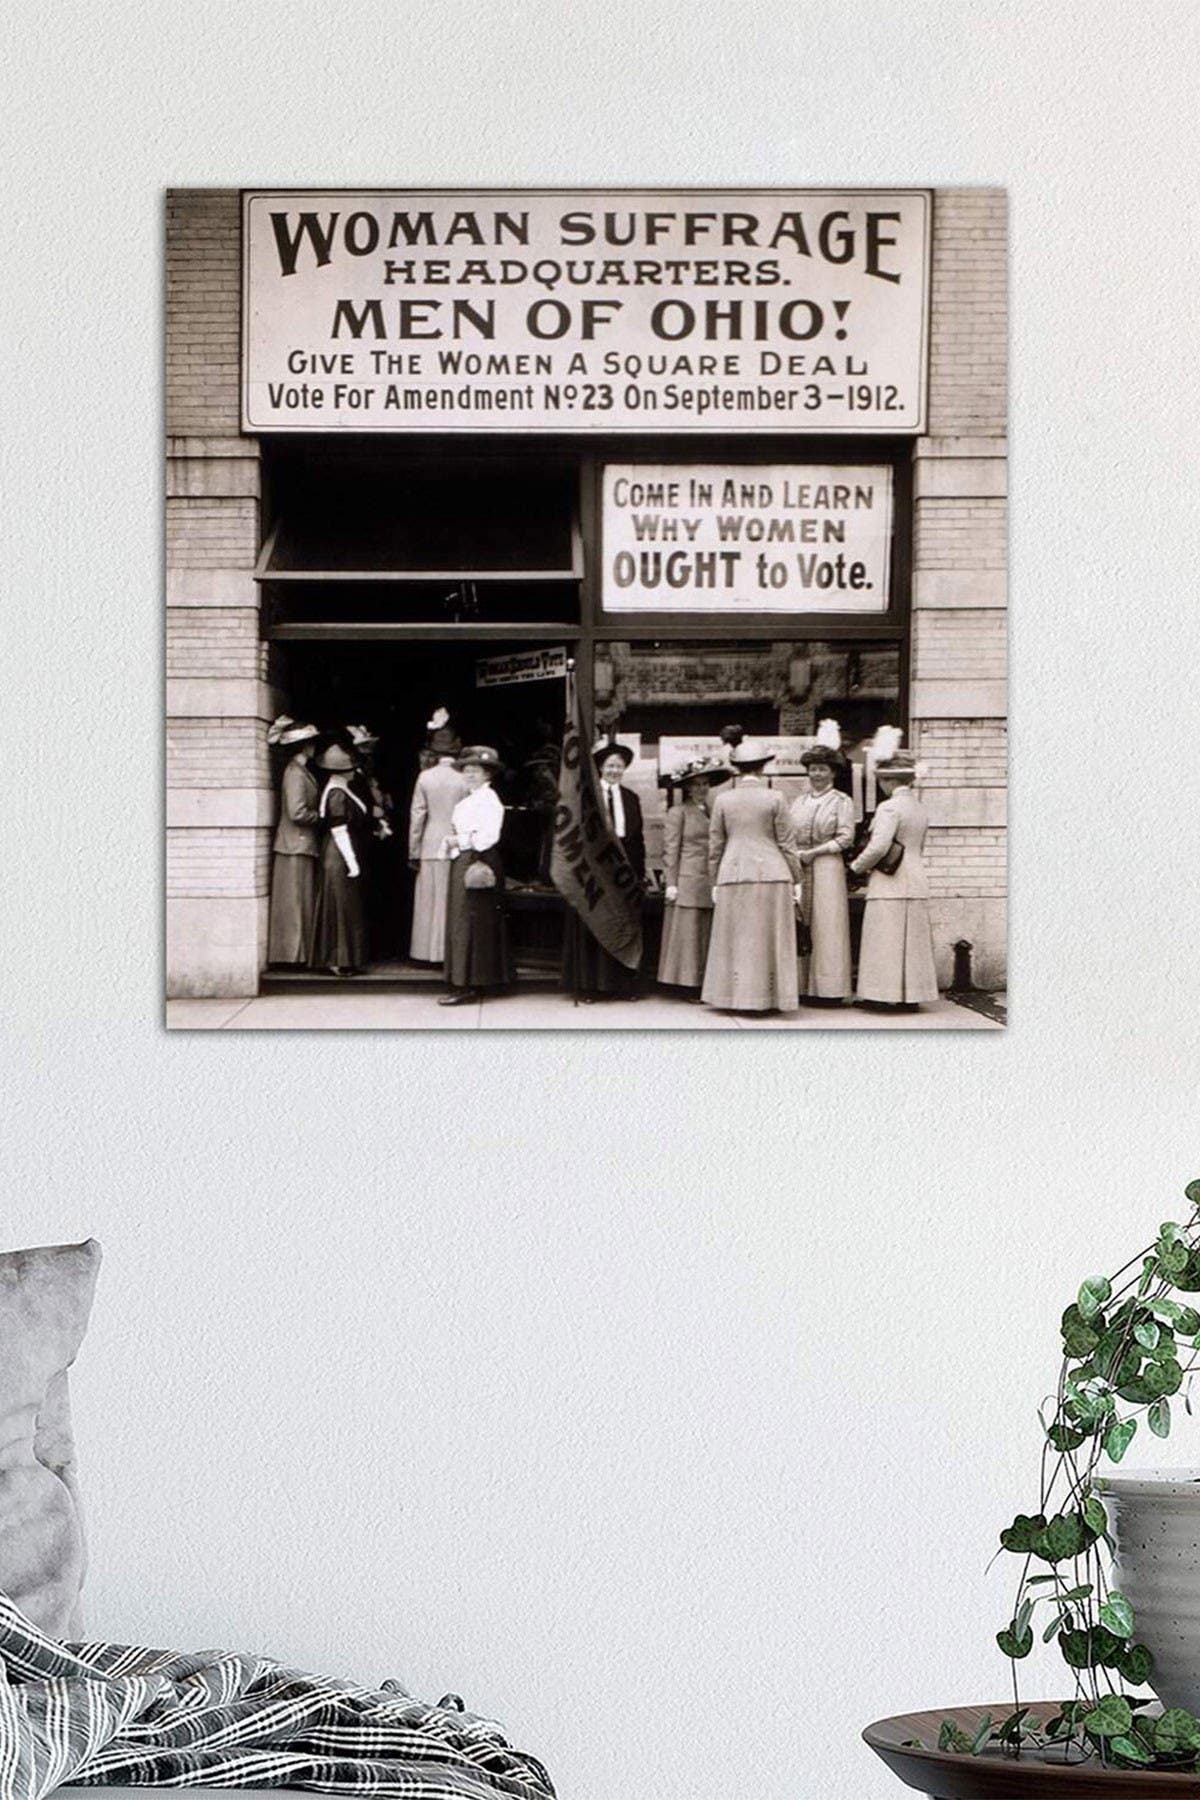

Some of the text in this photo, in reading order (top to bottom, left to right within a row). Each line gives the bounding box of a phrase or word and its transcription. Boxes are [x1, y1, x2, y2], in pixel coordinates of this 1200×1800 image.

[268, 210, 902, 285] WOMAN SUFFRAGE
[383, 259, 791, 291] HEADQUARTERS.
[331, 299, 851, 341] MEN OF OHIO!
[287, 349, 868, 379] GIVE THE WOMEN A SQUARE DEAL
[268, 383, 324, 409] Vote
[334, 384, 375, 410] For
[384, 384, 534, 410] Amendment
[624, 384, 657, 410] On
[663, 384, 799, 415] September
[613, 477, 874, 510] COME IN AND LEARN
[631, 514, 846, 544] WHY WOMEN
[613, 550, 874, 591] OUGHT to Vote.
